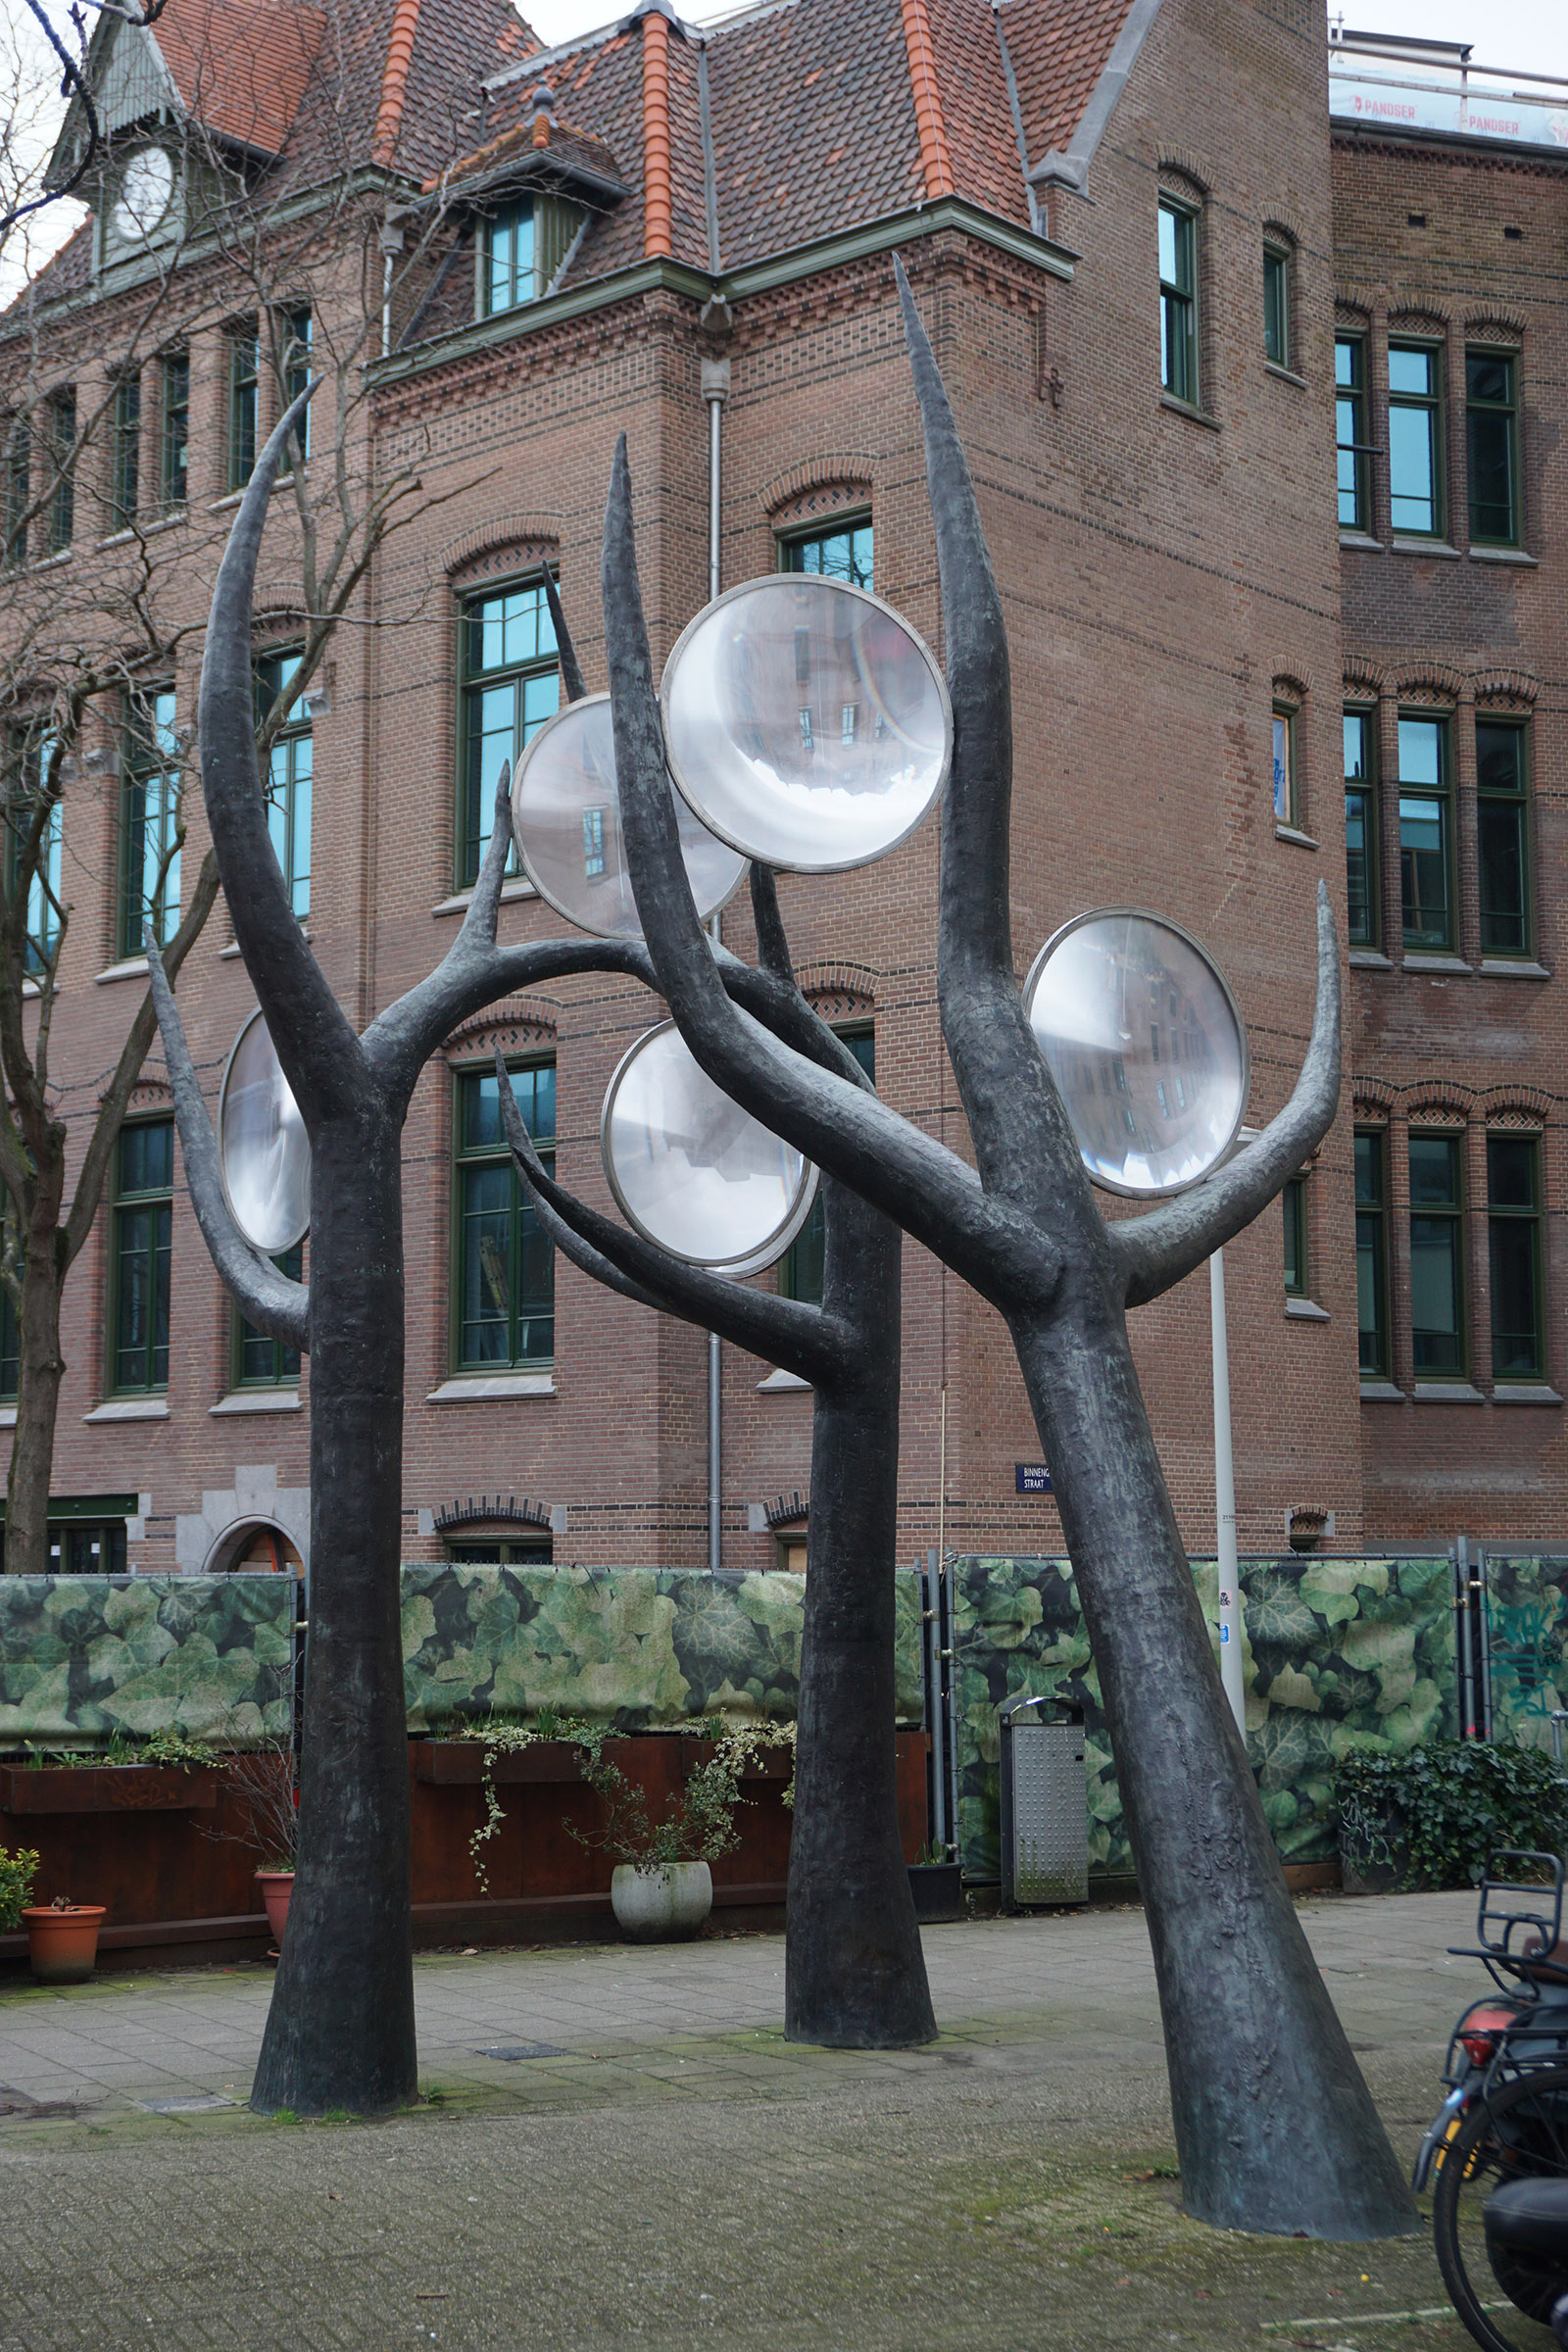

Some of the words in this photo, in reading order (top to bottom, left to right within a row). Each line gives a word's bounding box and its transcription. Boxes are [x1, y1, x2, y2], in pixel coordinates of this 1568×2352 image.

[1365, 99, 1416, 120] PANDSER
[1469, 115, 1519, 134] PANDSER
[1024, 1467, 1050, 1477] BINNENG
[1024, 1479, 1044, 1489] STRAAT
